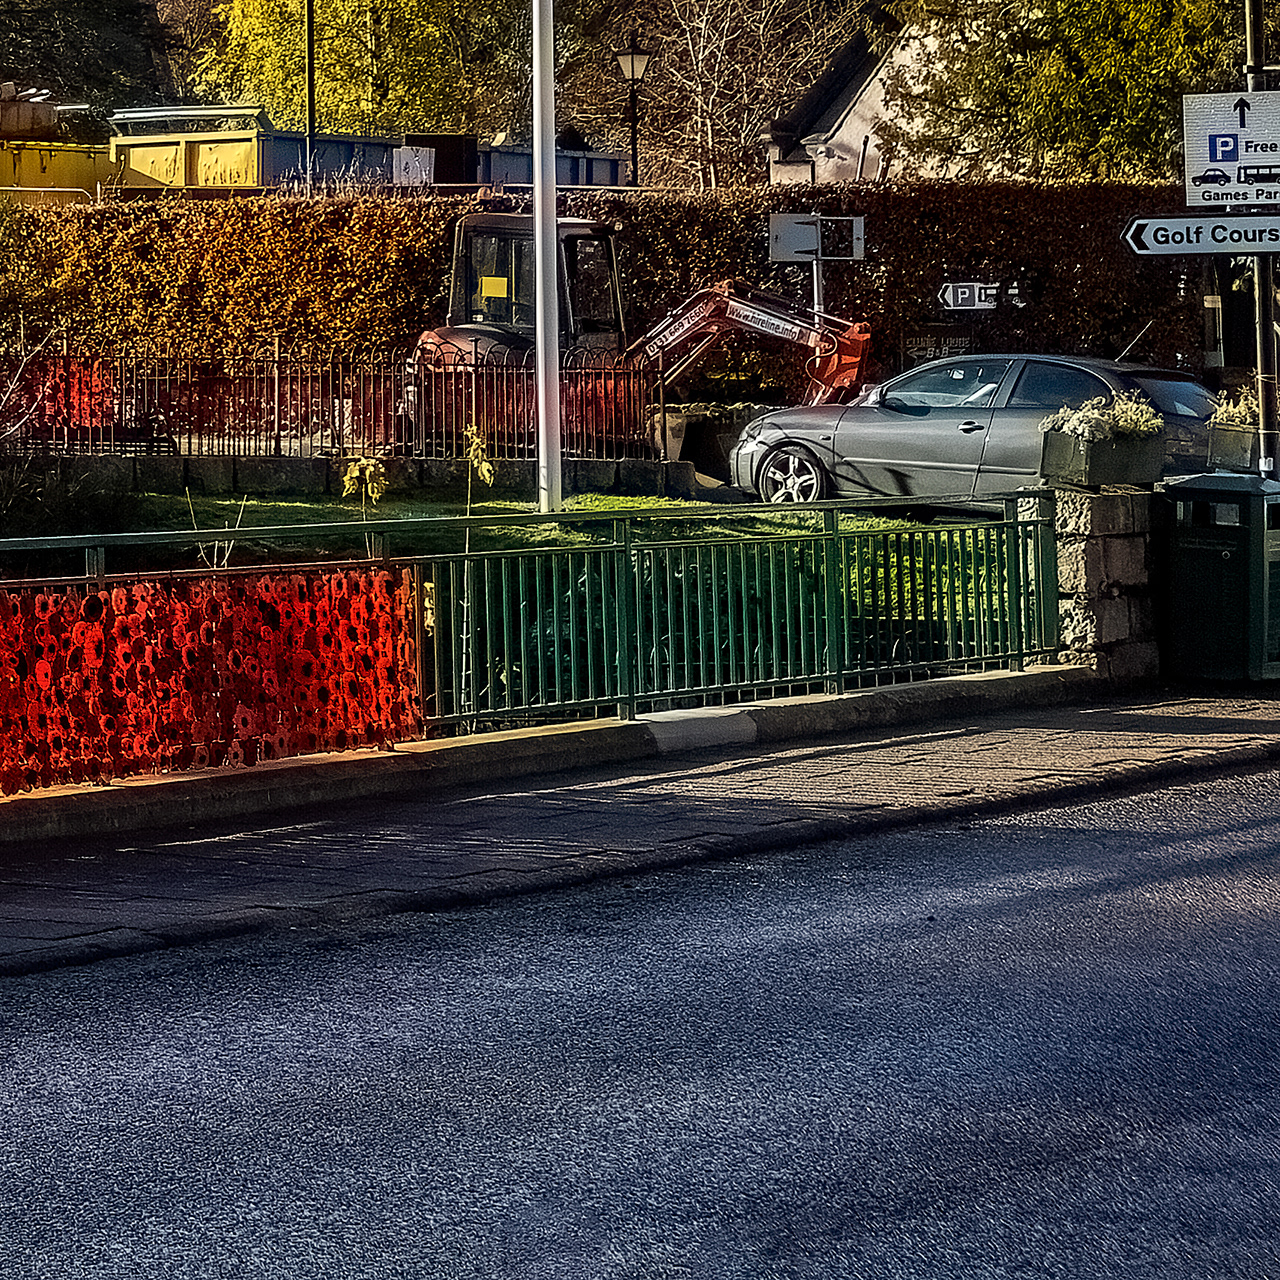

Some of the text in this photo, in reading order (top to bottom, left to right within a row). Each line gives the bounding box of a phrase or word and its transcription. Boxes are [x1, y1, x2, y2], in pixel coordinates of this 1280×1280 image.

[1216, 137, 1279, 160] P Free
[1201, 188, 1280, 201] Games Par
[1152, 224, 1280, 245] Golf Cours
[957, 288, 970, 304] P
[648, 332, 670, 354] 0131
[669, 321, 686, 338] 669
